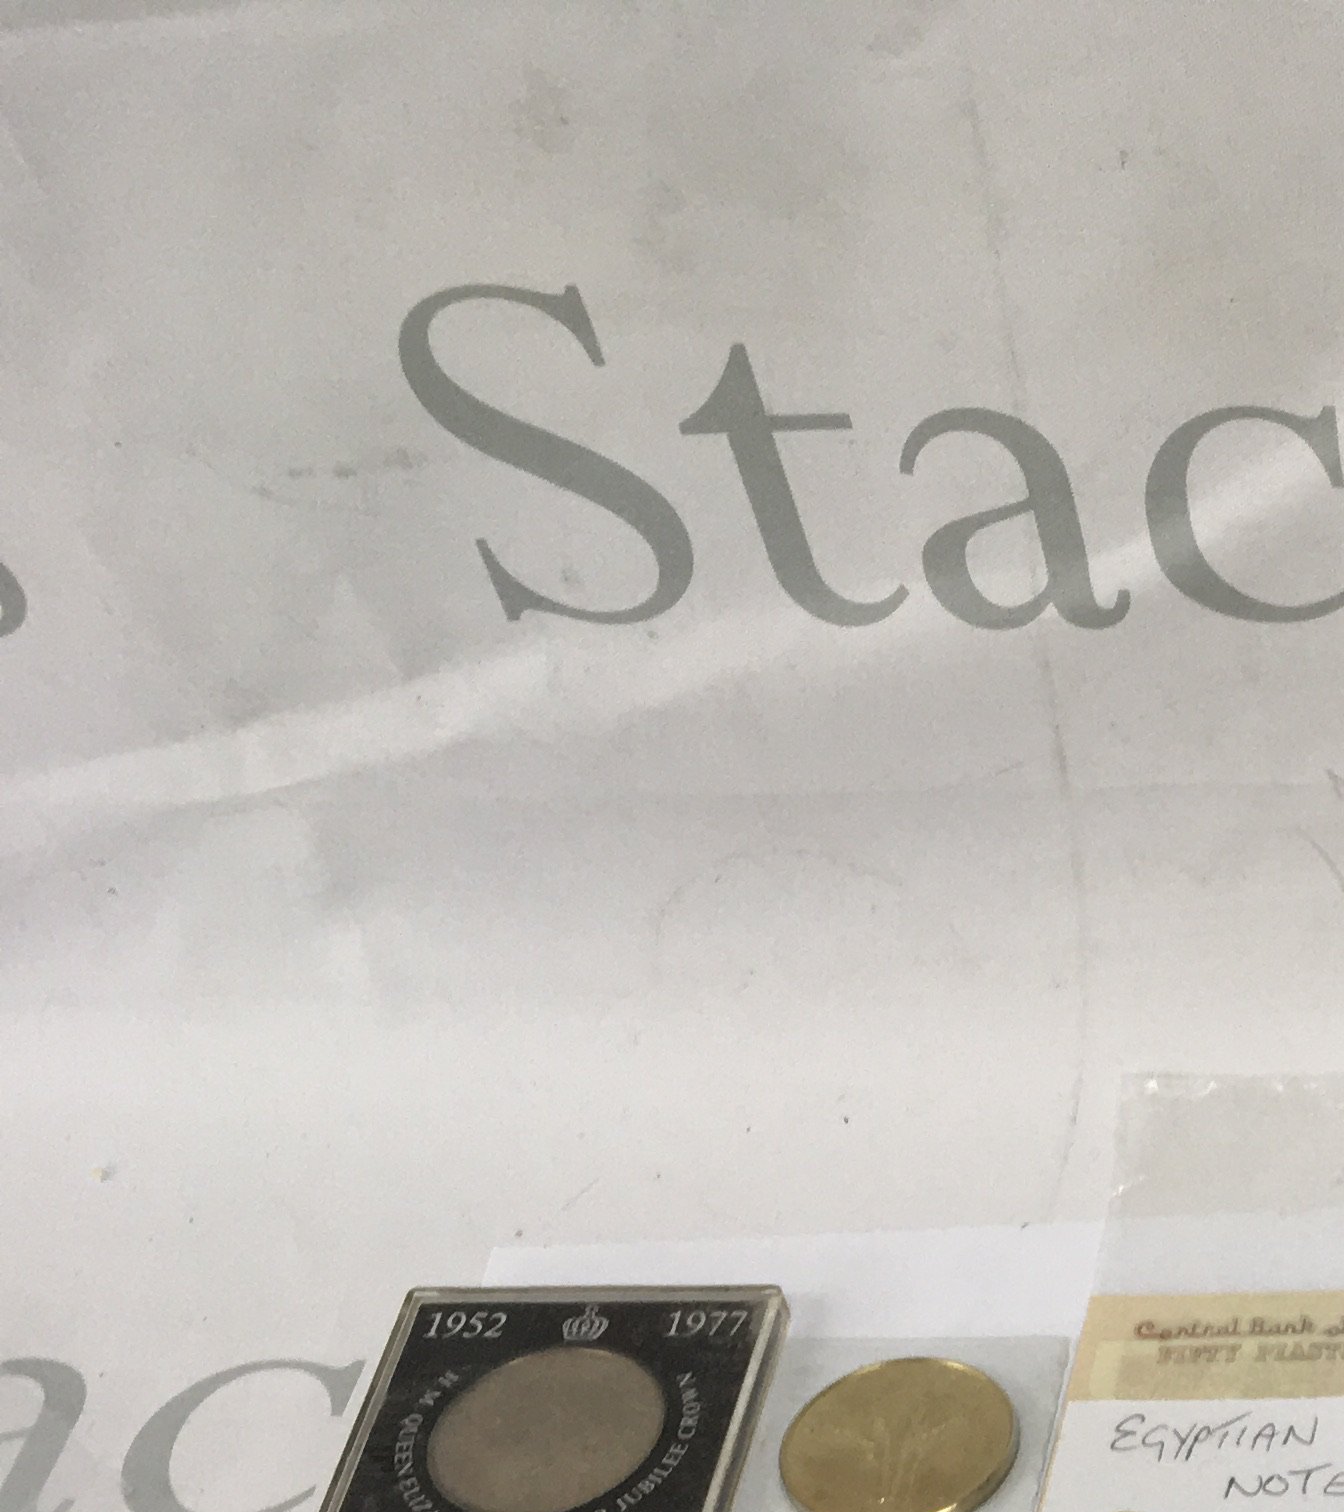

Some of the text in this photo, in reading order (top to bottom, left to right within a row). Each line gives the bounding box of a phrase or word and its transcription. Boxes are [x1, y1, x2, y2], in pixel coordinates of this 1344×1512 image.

[422, 1311, 507, 1339] 1952
[663, 1310, 748, 1338] 1977
[616, 1441, 690, 1512] JUBILEE
[675, 1370, 701, 1440] CROWN
[1109, 1410, 1319, 1462] EGYPTIAN
